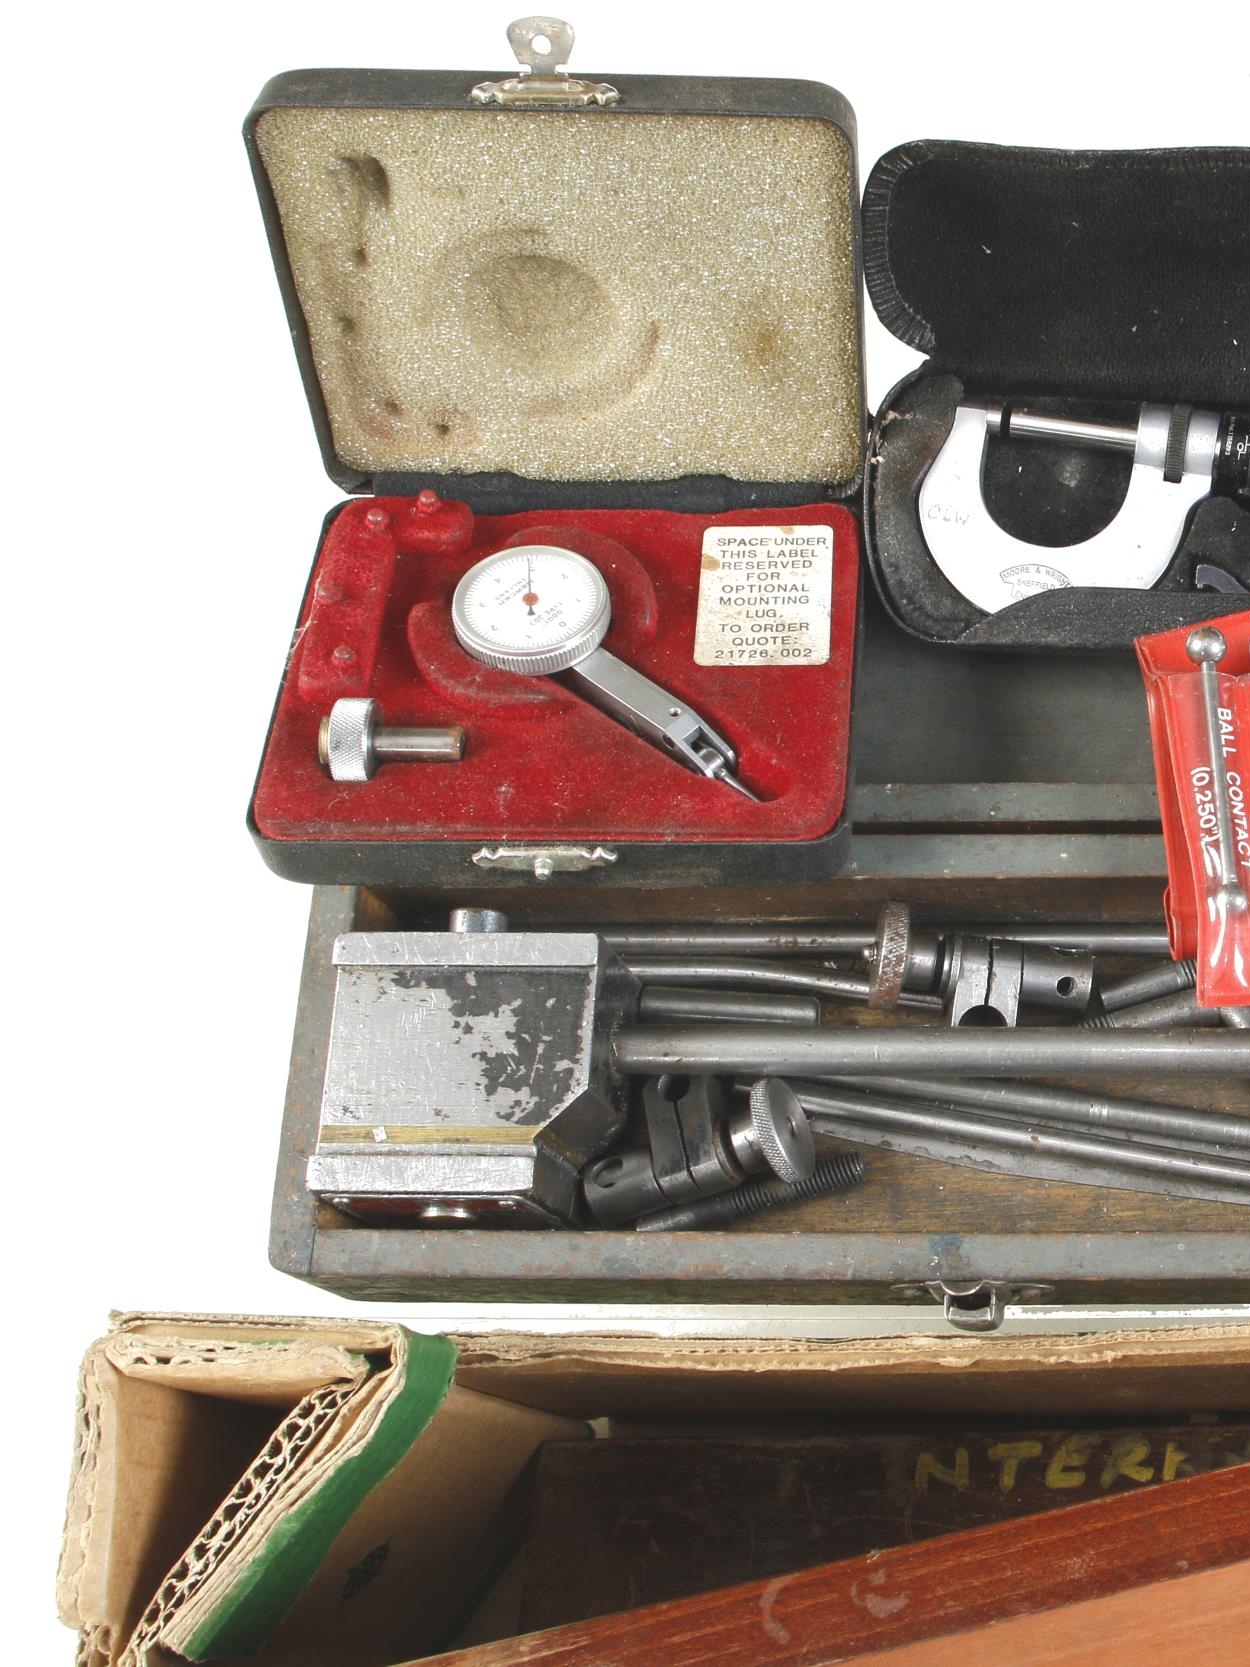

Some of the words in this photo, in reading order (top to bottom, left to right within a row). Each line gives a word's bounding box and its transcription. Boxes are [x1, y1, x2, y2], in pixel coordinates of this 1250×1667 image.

[717, 537, 769, 547] SPACE
[774, 537, 827, 546] UNDER
[720, 550, 757, 559] THIS
[767, 549, 819, 558] LABEL
[722, 560, 813, 570] RESERVED
[746, 572, 781, 581] FOR
[721, 584, 810, 594] OPTIONAL
[719, 595, 810, 606] MOUNTING
[719, 624, 741, 633] TO
[750, 622, 810, 632] ORDER
[732, 636, 798, 646] QUOTE:
[1217, 707, 1237, 758] BALL
